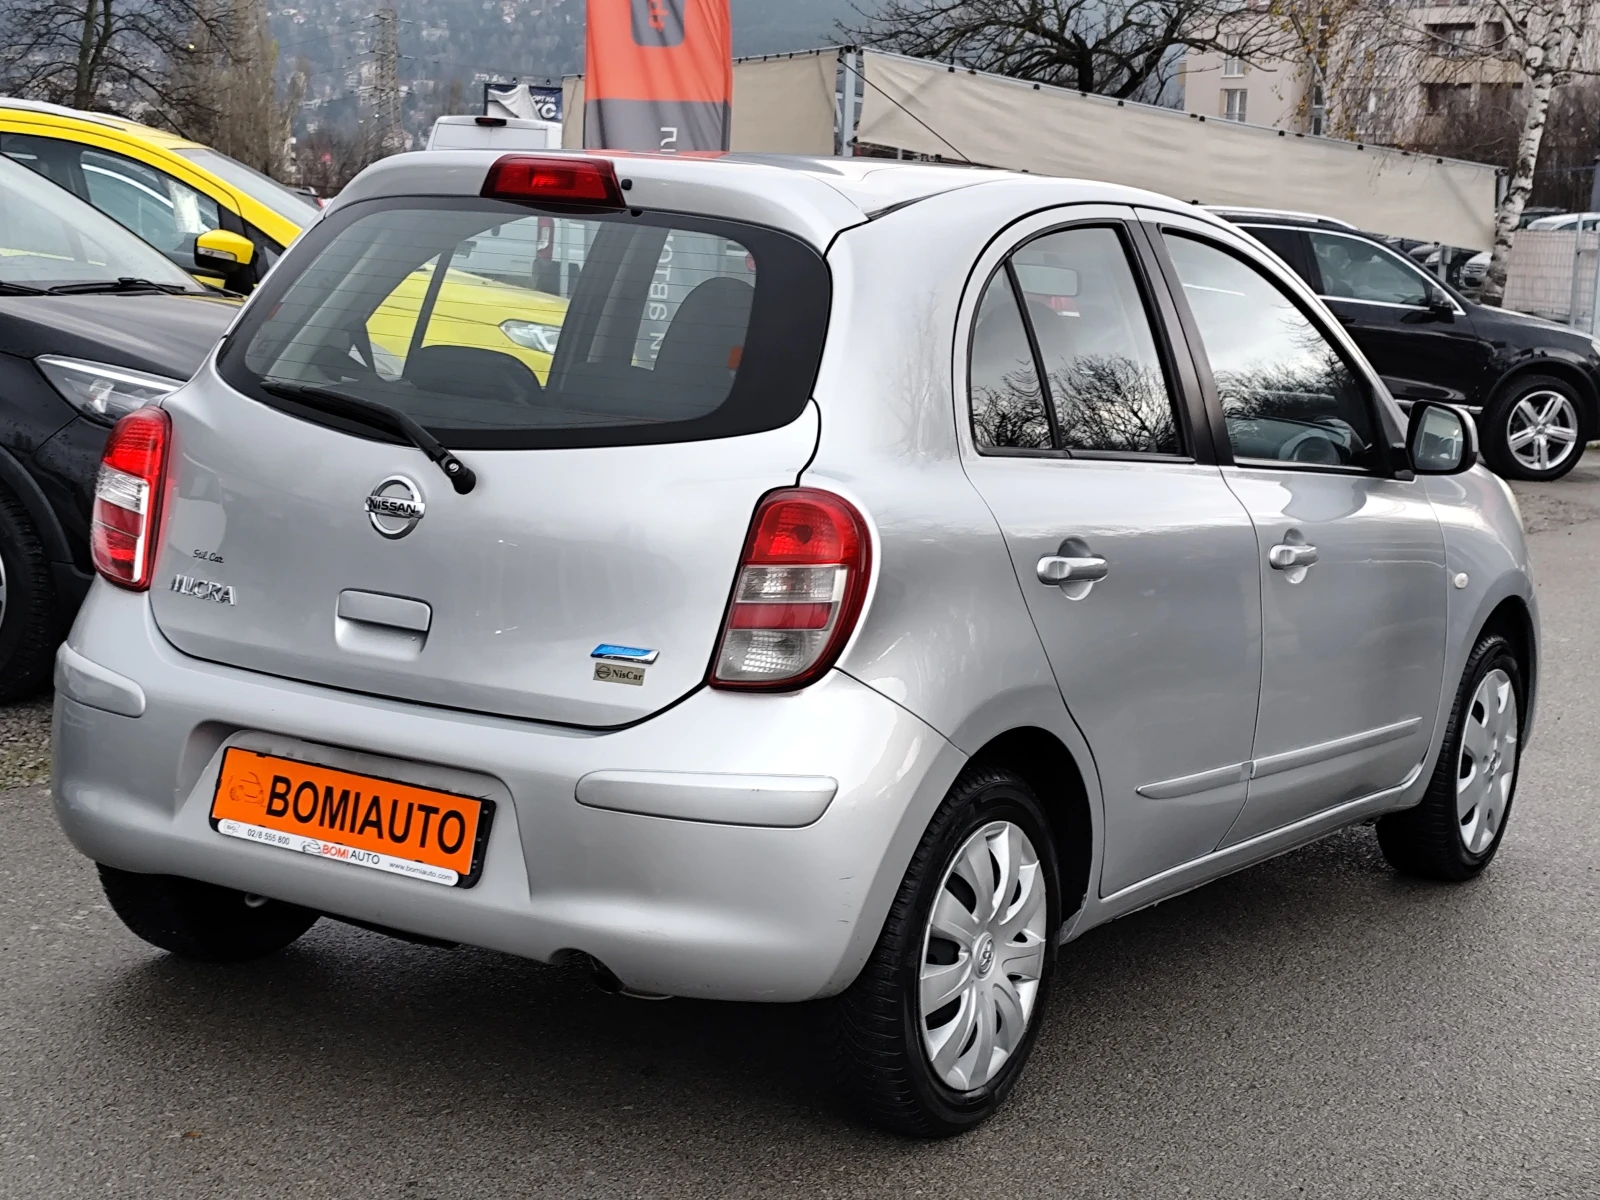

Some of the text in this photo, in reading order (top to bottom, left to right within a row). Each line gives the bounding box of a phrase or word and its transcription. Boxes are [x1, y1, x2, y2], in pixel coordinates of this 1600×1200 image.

[369, 498, 418, 515] NISSAN
[611, 669, 643, 681] NisCar
[265, 774, 466, 855] BOMIAUTO
[247, 829, 290, 845] 02/8 555 800
[389, 862, 453, 881] www.bomiauto.com
